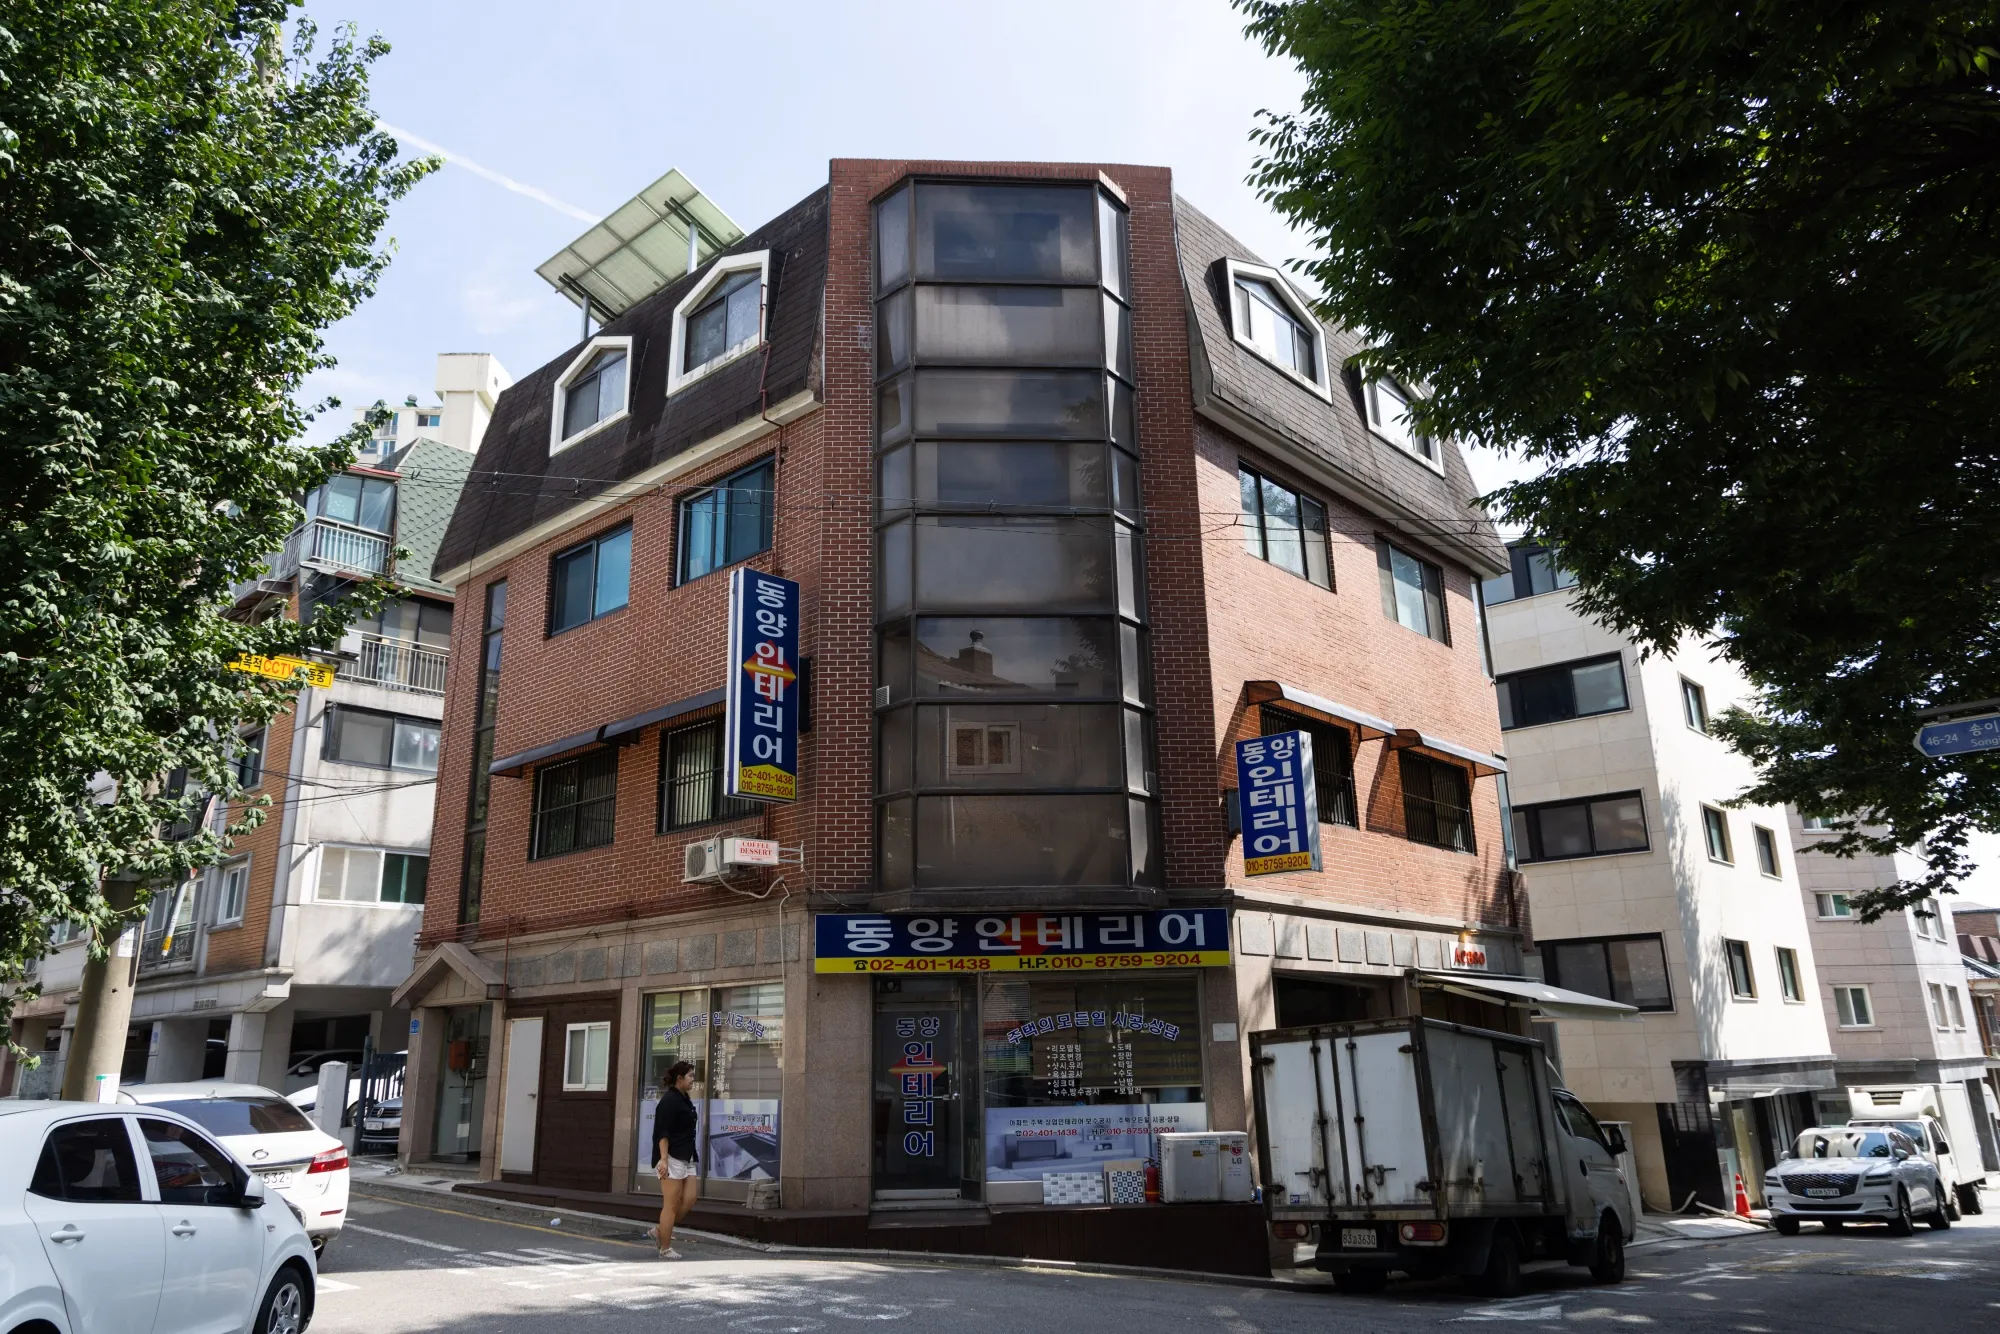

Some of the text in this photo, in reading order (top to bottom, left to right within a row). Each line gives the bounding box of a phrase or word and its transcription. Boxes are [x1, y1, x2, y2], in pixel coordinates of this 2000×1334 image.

[752, 578, 788, 764] 동양인테리어
[1926, 734, 1958, 746] 46-24
[1242, 736, 1296, 764] 동양
[742, 768, 794, 785] 02-401-1438
[741, 780, 794, 797] 010-8759-9204
[1248, 760, 1300, 853] 인테리어
[740, 848, 772, 856] DESSERT
[1246, 855, 1308, 872] 010-8759-9204
[844, 913, 1206, 952] 동양인테리어
[870, 953, 1202, 971] 02-401-1438 H.P. 010-8759-9204
[1454, 947, 1486, 966] Acaso
[896, 1016, 940, 1038] 동양
[1051, 1044, 1081, 1052] 리모델링
[1052, 1053, 1082, 1062] 구조변경
[1118, 1052, 1132, 1060] 장판
[1118, 1060, 1132, 1068] 타일
[1052, 1070, 1082, 1078] 욕실공사
[1118, 1069, 1133, 1077] 수도
[1053, 1080, 1074, 1088] 싱크대
[1119, 1078, 1133, 1086] 난방
[1120, 1086, 1142, 1095] 보일러
[902, 1042, 934, 1156] 인테리어
[1022, 1129, 1078, 1137] 02-401-1438
[1106, 1127, 1176, 1135] 010-8759-9204
[258, 1172, 285, 1184] 532
